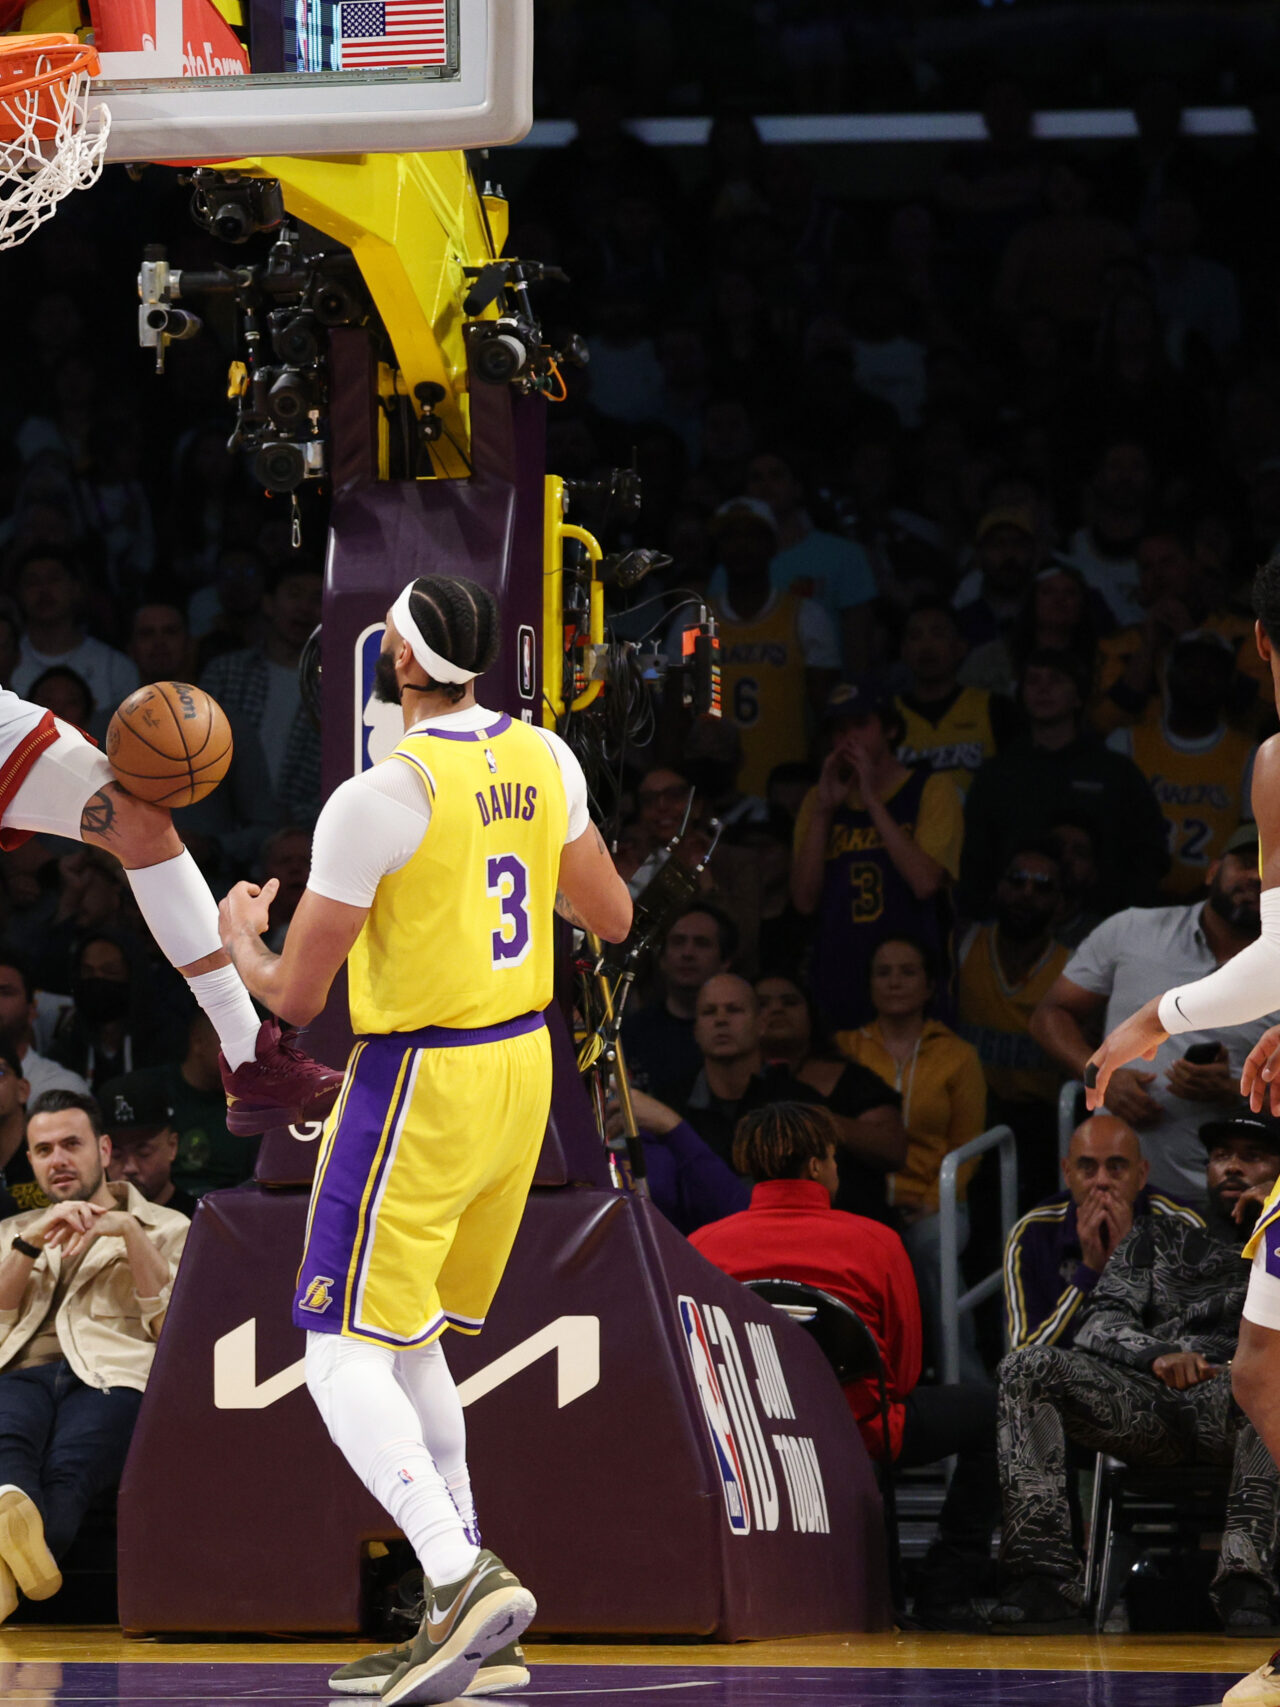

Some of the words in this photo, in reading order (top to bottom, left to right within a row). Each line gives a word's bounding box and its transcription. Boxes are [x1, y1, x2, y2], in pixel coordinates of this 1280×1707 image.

[734, 678, 760, 723] 6
[475, 782, 537, 827] DAVIS
[486, 852, 532, 970] 3
[848, 861, 885, 923] 3
[744, 1321, 797, 1421] JOIN
[771, 1433, 831, 1534] TODAY
